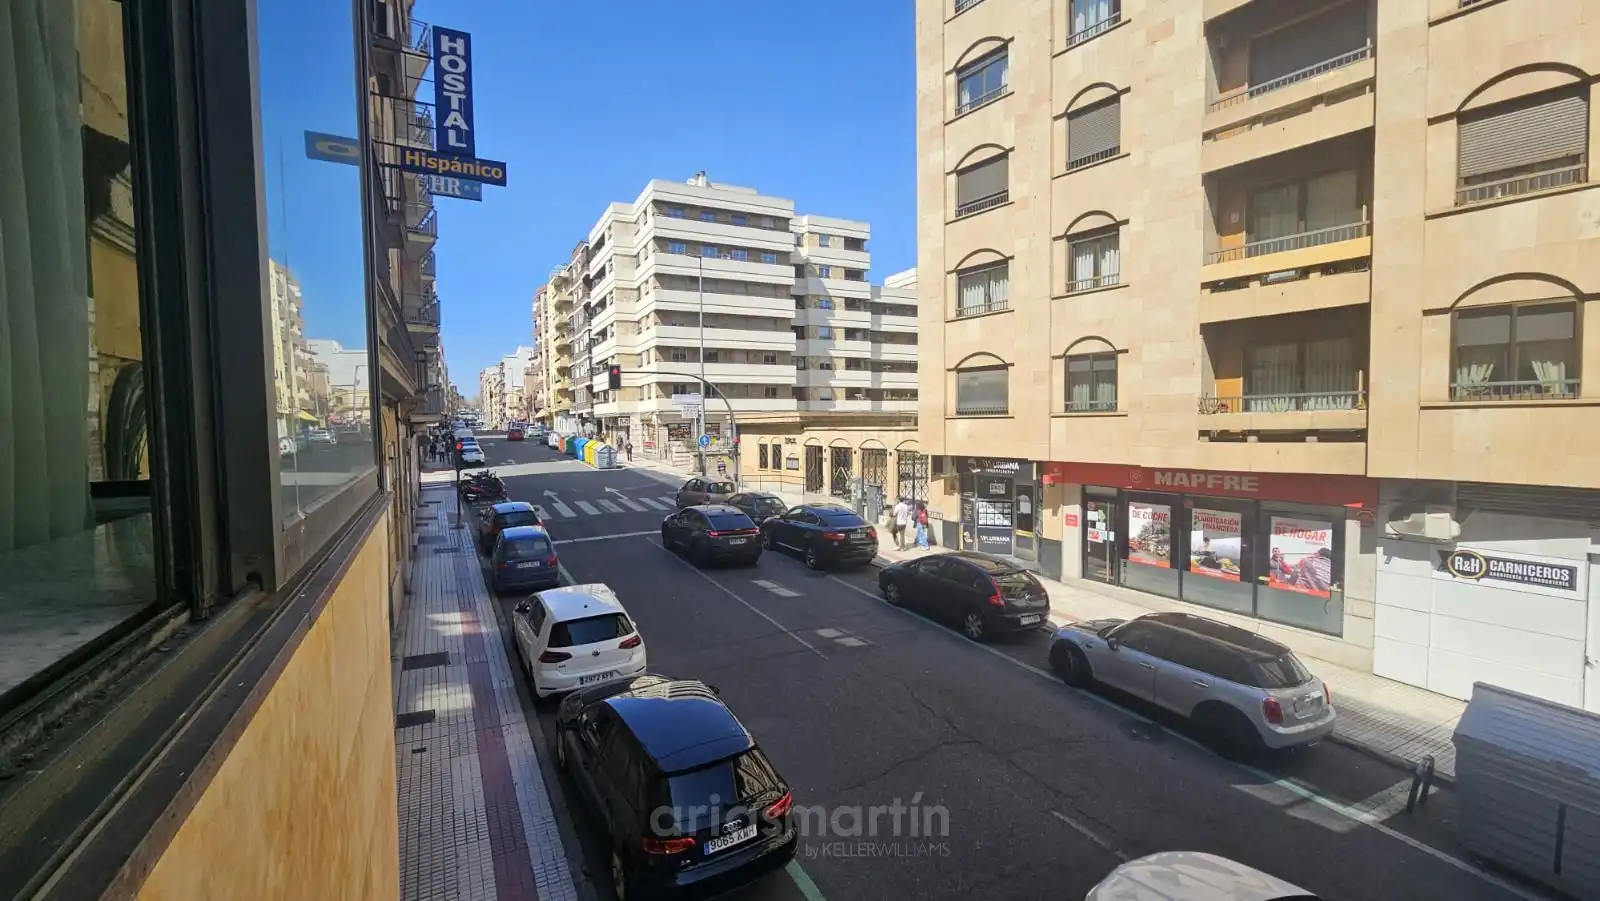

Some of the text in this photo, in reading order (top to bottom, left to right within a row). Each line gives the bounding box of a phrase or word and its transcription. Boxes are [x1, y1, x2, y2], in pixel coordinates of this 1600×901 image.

[439, 34, 470, 148] HOSTAL
[405, 150, 503, 179] Hispánico
[430, 174, 461, 195] HR
[1154, 471, 1260, 492] MAPFRE
[1131, 510, 1169, 521] DE COCHE
[1275, 526, 1327, 542] DE HOGAR
[1454, 555, 1570, 581] R&H CARNICEROS
[710, 834, 735, 850] 9065
